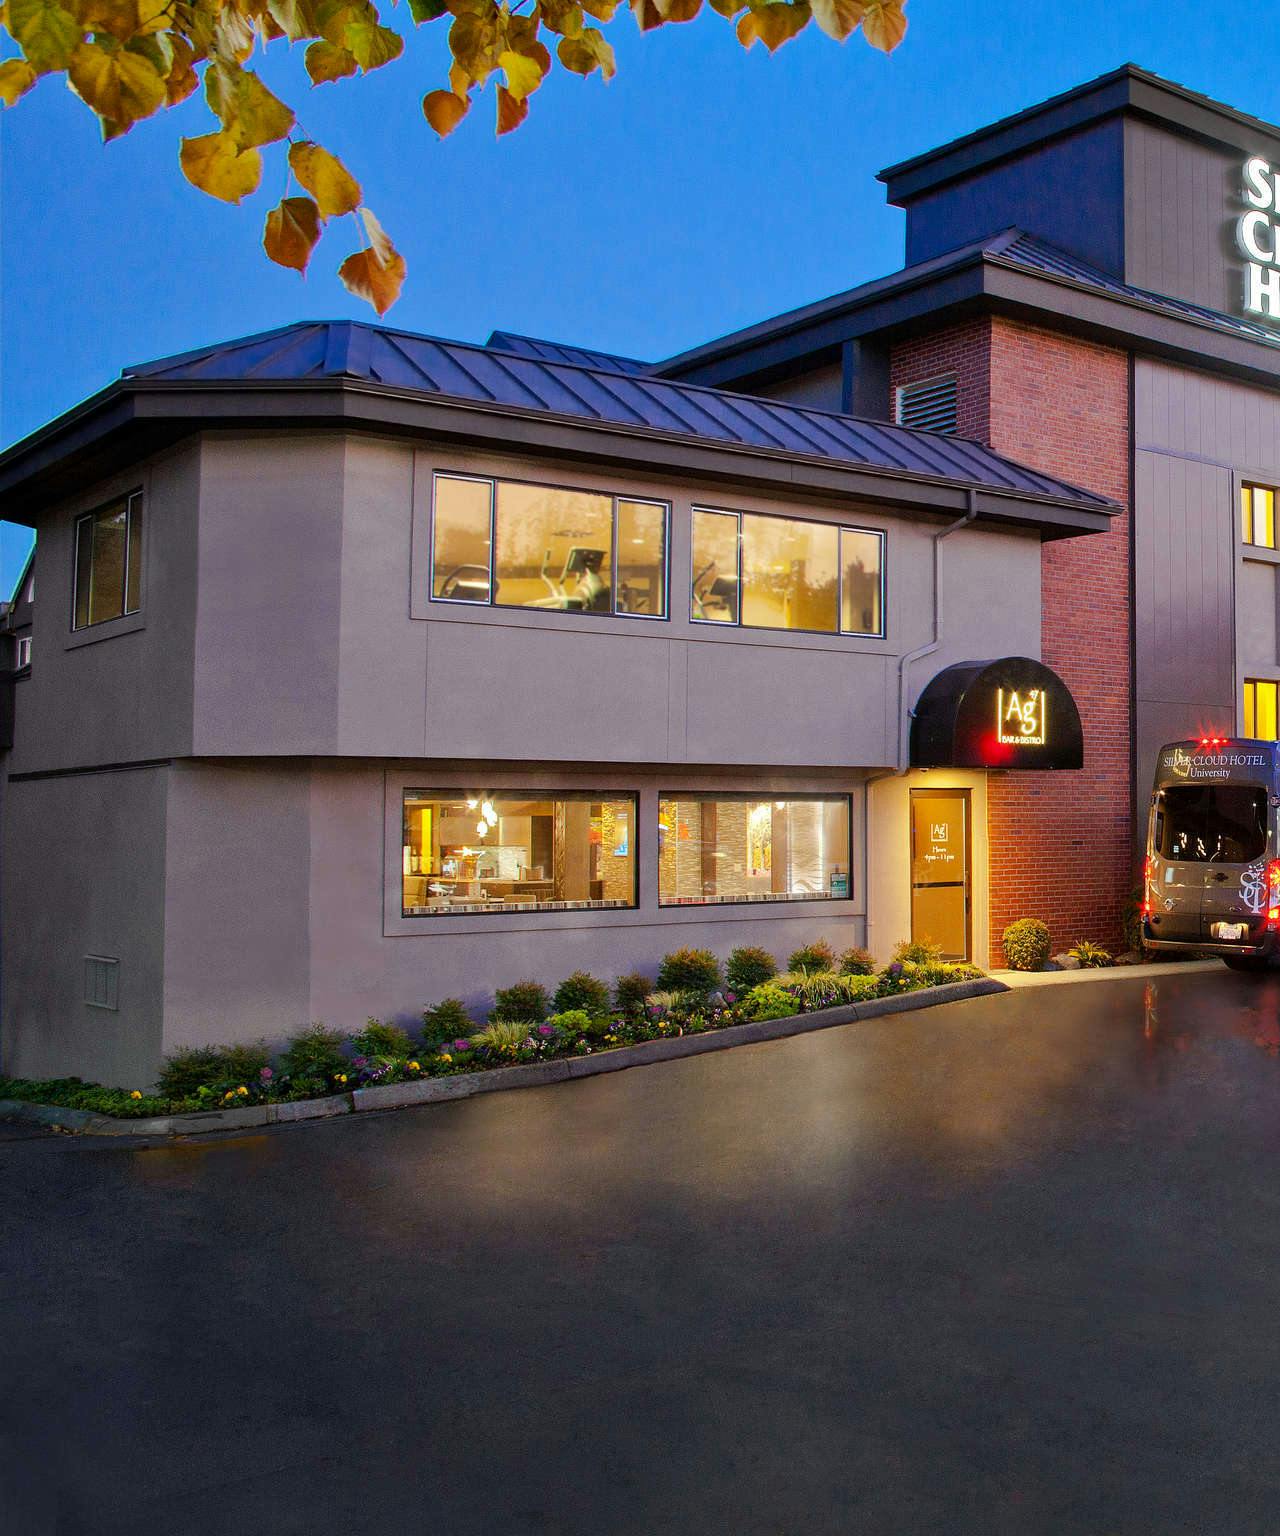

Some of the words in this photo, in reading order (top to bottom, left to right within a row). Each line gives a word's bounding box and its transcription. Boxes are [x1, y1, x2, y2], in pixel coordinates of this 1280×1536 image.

[1193, 755, 1228, 766] CLOUD
[1229, 755, 1266, 766] HOTEL
[1190, 767, 1231, 779] University
